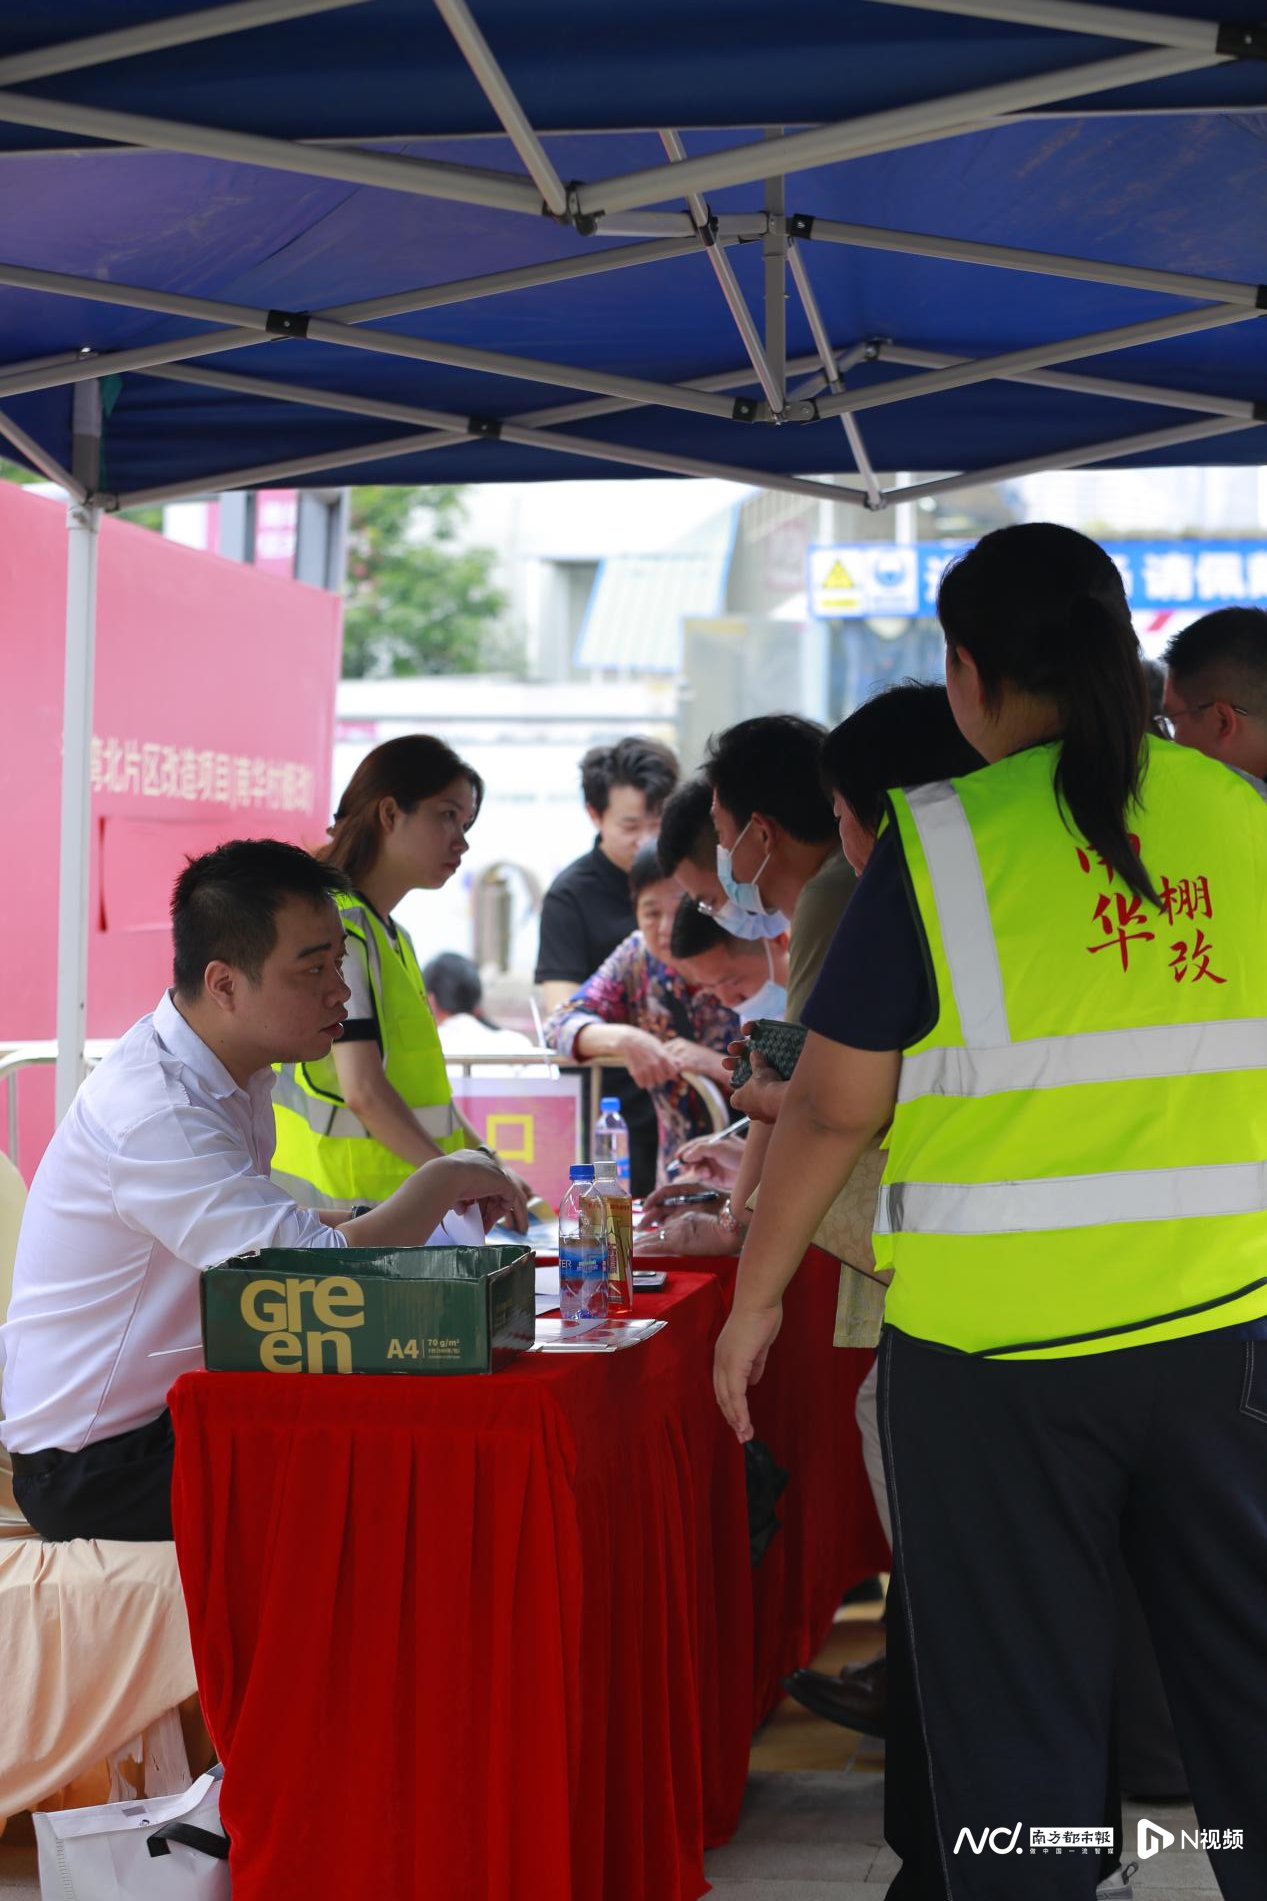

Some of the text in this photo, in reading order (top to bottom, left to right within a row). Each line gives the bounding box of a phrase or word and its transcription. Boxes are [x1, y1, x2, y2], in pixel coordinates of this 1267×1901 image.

[240, 1276, 365, 1332] Gre
[259, 1331, 353, 1374] en
[386, 1338, 419, 1359] A4
[427, 1339, 438, 1347] 70
